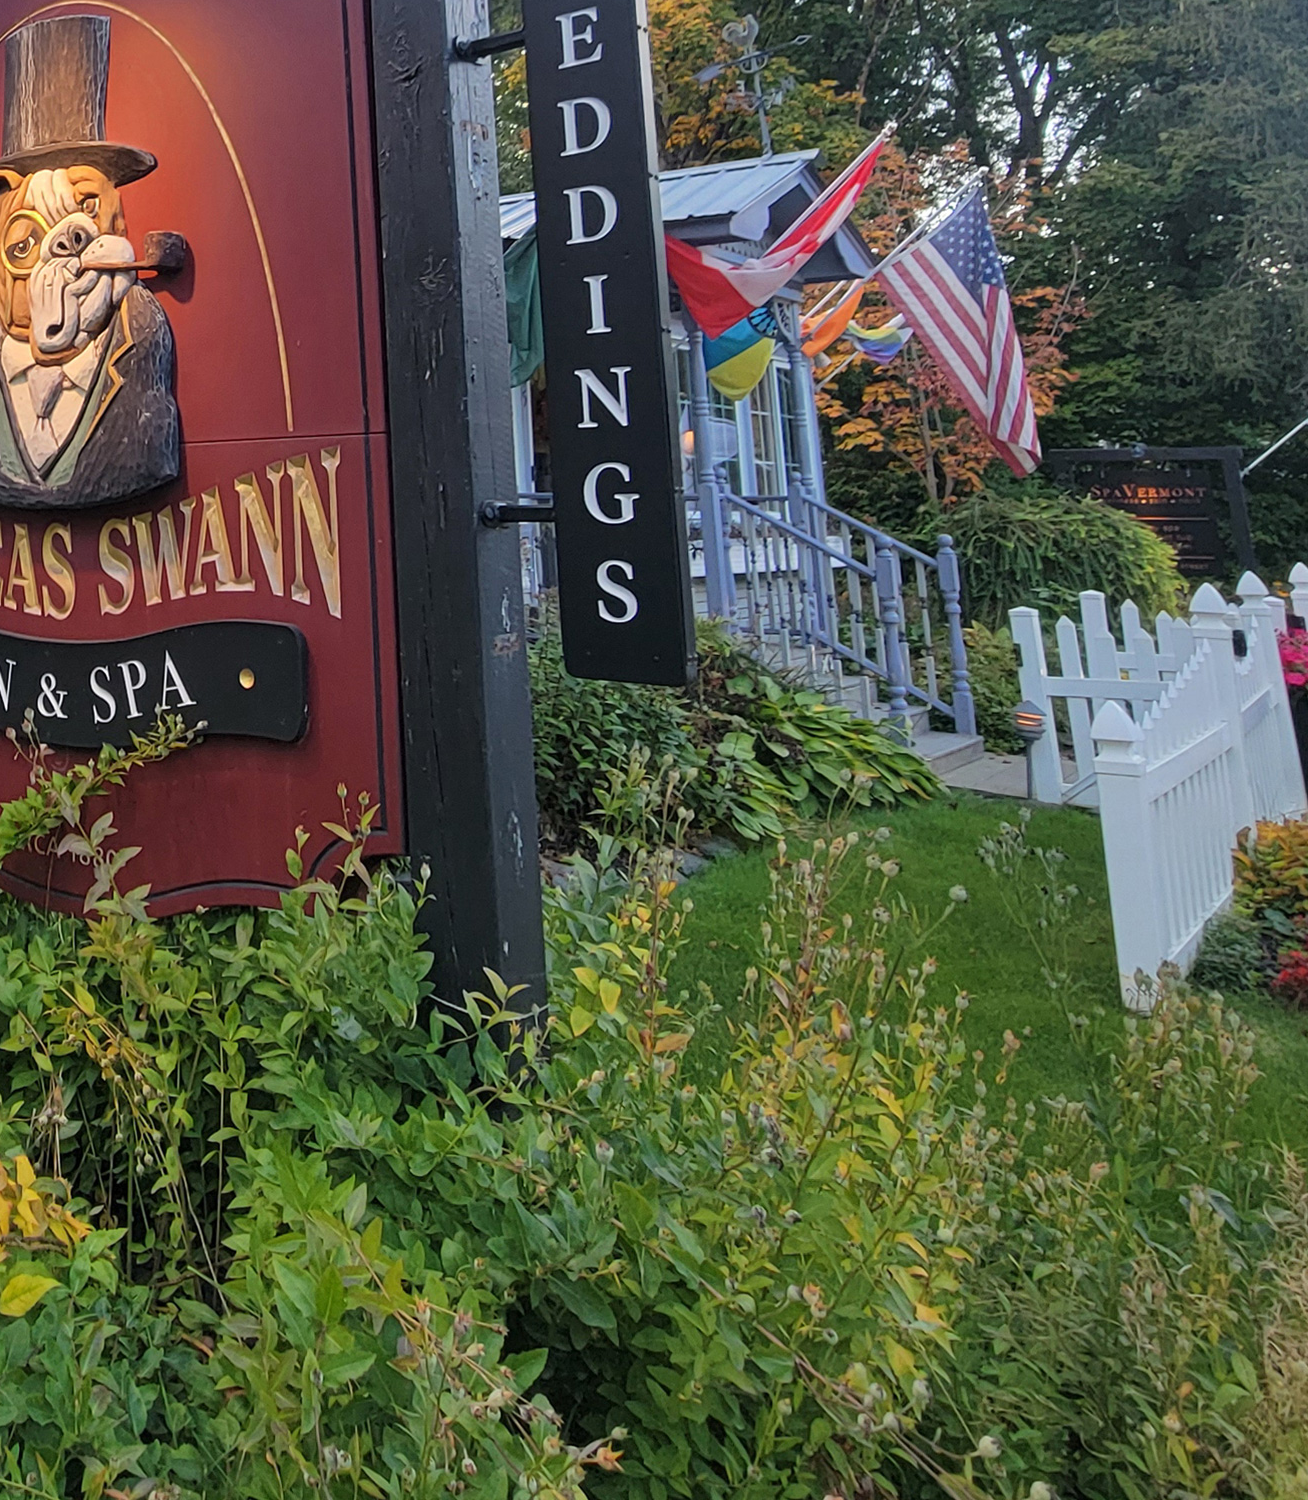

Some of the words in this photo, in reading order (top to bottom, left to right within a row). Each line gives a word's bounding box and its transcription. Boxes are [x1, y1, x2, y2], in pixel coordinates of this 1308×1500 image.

[98, 445, 342, 619] SWANN
[37, 672, 69, 720] &
[89, 650, 197, 725] SPA
